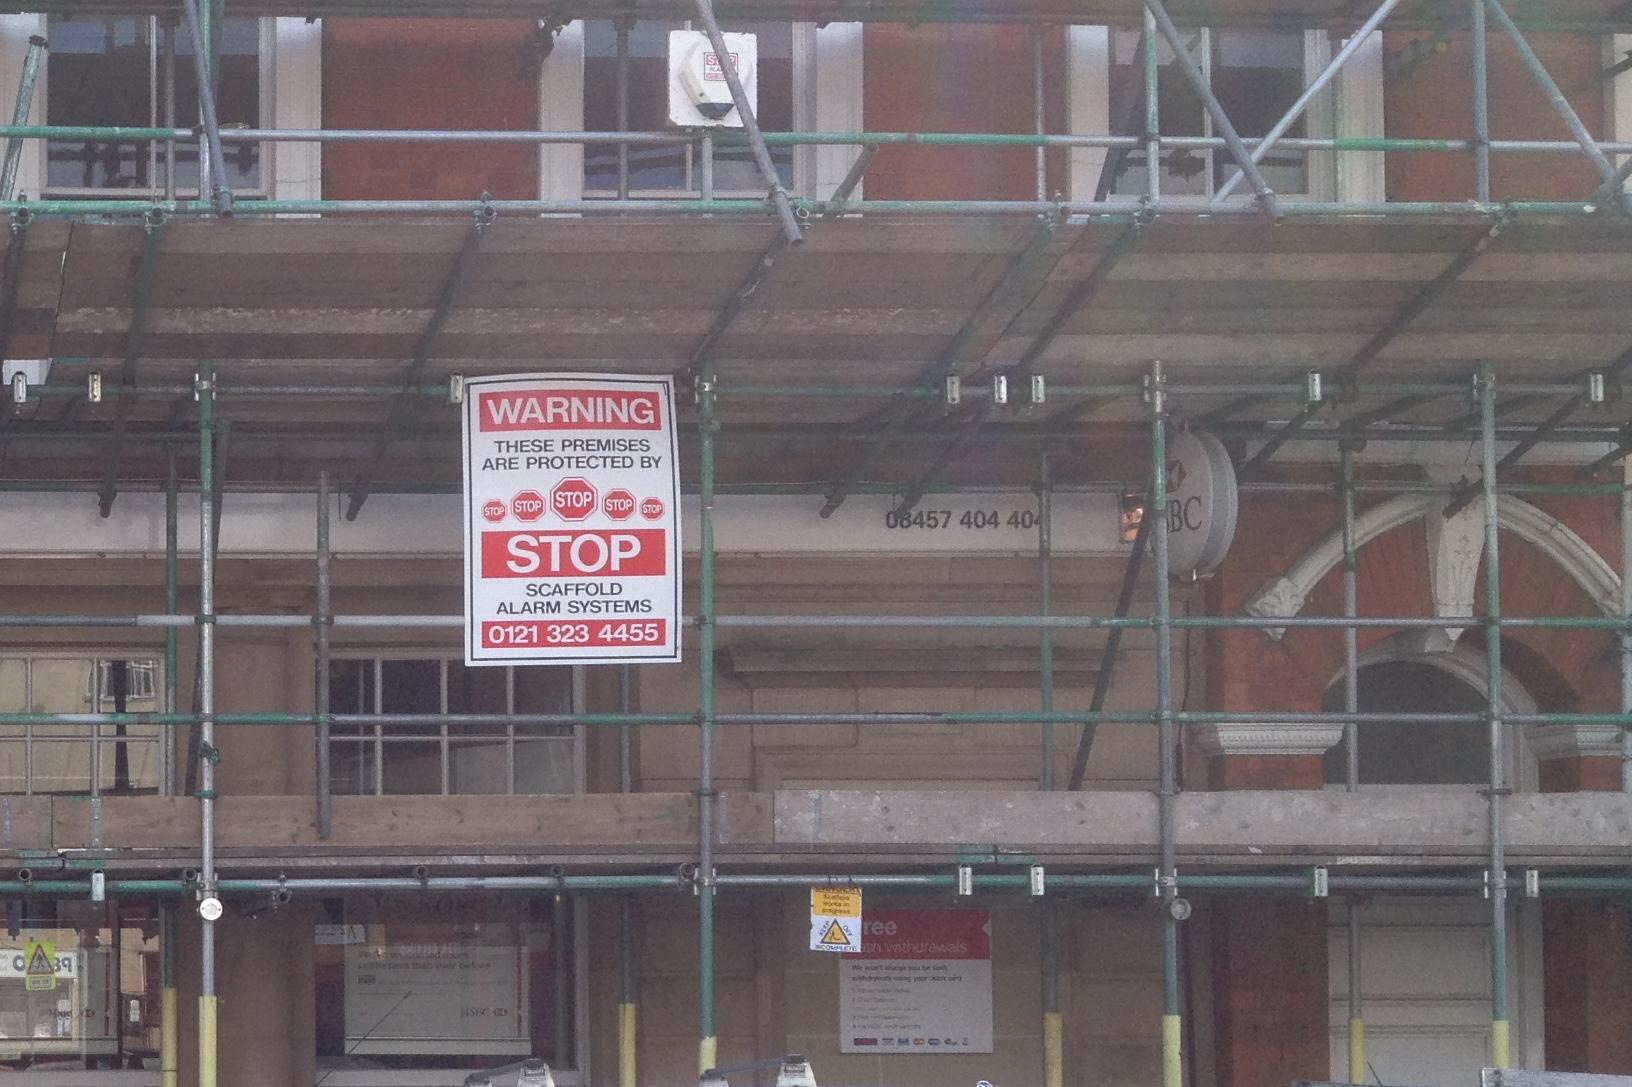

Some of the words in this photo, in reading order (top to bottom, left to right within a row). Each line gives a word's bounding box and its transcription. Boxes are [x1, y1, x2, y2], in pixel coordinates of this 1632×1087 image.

[708, 55, 736, 65] STP
[486, 396, 655, 425] WARNING
[494, 439, 555, 453] THESE
[561, 439, 650, 452] PREMISES
[481, 456, 519, 471] ARE
[526, 455, 634, 470] PROTECTED
[640, 455, 662, 469] BY
[514, 500, 542, 513] STOP
[555, 491, 592, 508] STOP
[606, 499, 632, 512] STOP
[484, 506, 505, 516] STOP
[642, 504, 662, 514] STOP
[1168, 496, 1202, 532] BC
[886, 511, 952, 528] 08457
[960, 511, 1000, 528] 404
[506, 534, 642, 573] STOP
[526, 583, 623, 597] SCAFFOLD
[496, 601, 561, 615] ALARM
[568, 599, 652, 614] SYSTEMS
[488, 625, 538, 644] 0121
[546, 624, 590, 643] 323
[598, 623, 659, 642] 4455
[863, 921, 897, 935] ree
